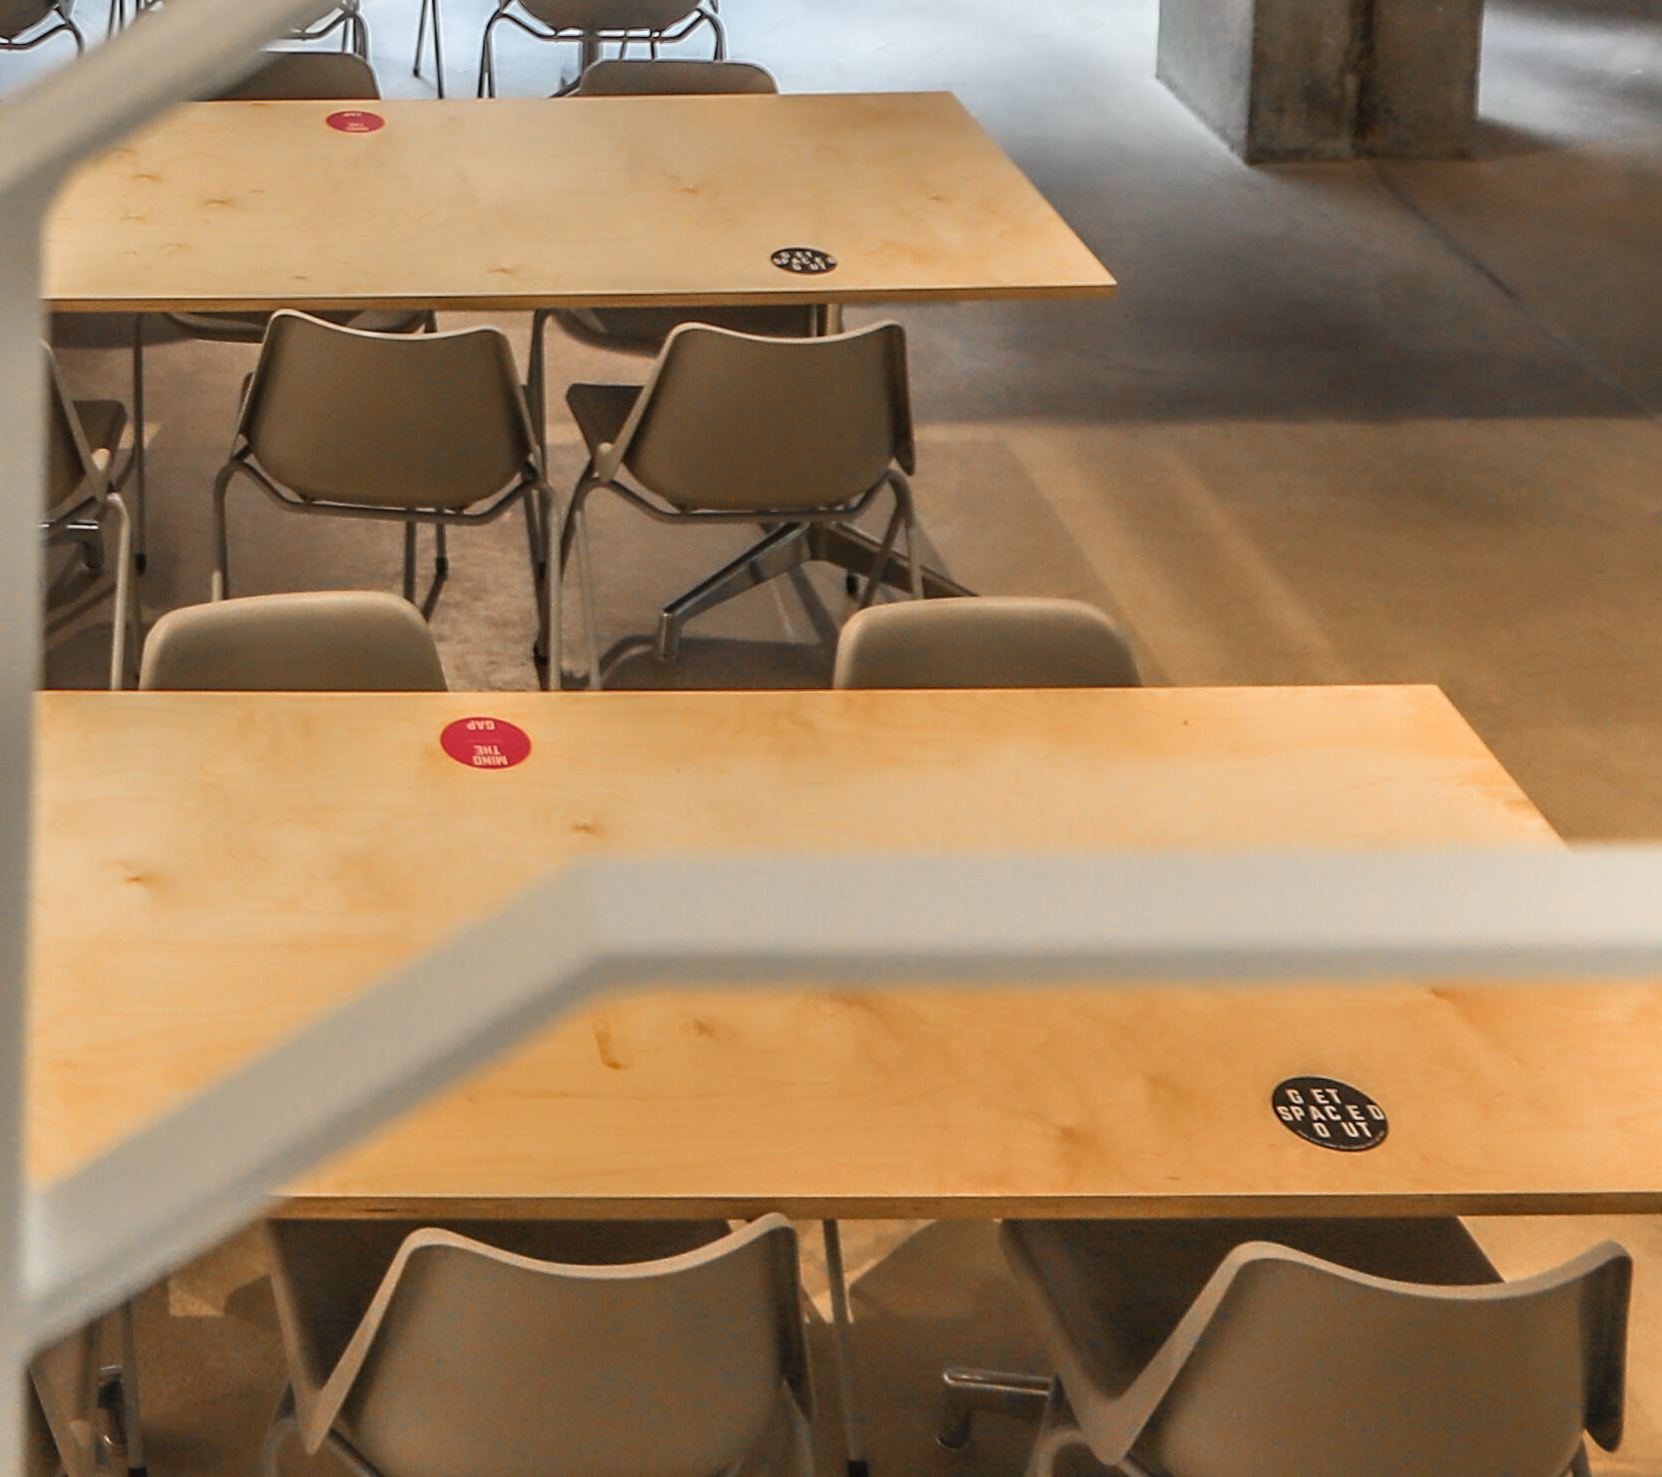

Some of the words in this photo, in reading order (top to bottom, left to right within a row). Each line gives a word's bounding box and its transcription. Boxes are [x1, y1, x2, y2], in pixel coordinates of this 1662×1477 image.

[466, 719, 496, 731] GAP
[473, 744, 501, 756] THE
[472, 754, 509, 766] MIND
